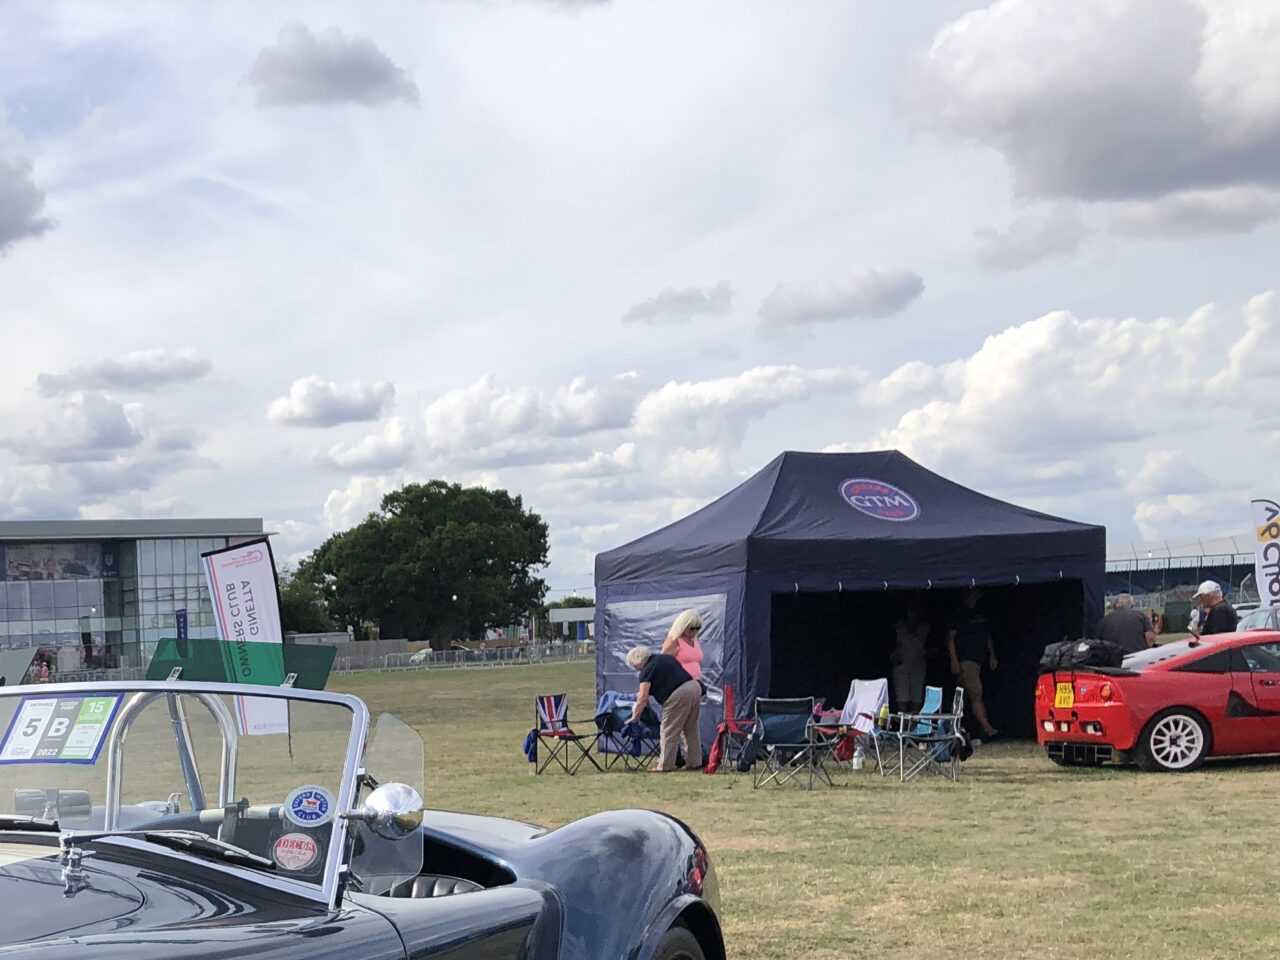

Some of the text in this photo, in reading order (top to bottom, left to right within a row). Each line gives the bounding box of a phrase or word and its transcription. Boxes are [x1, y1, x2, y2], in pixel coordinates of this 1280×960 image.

[850, 495, 910, 507] GTM
[22, 718, 41, 737] 5
[47, 717, 70, 737] B
